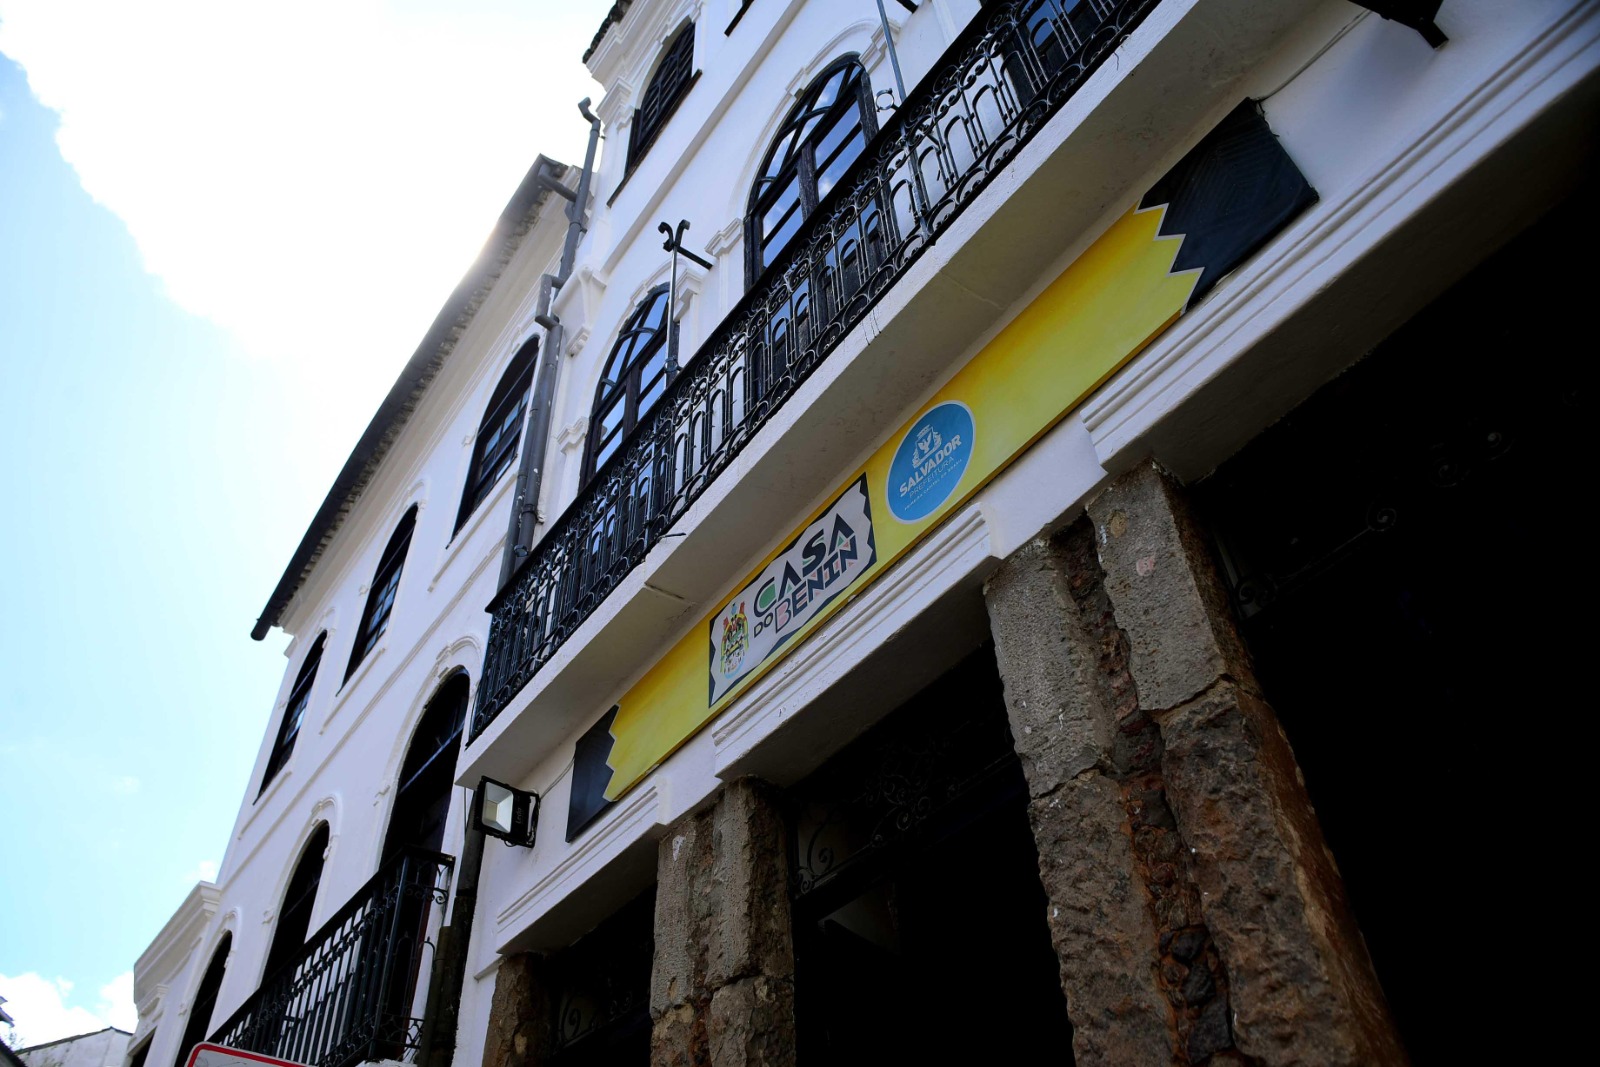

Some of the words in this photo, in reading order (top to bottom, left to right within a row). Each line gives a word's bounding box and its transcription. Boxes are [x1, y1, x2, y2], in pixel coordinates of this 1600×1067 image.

[899, 434, 962, 497] SALVADOR
[909, 456, 954, 498] PREFEITURA
[753, 513, 854, 618] CASA
[754, 613, 774, 638] DO
[775, 534, 858, 634] BENIN
